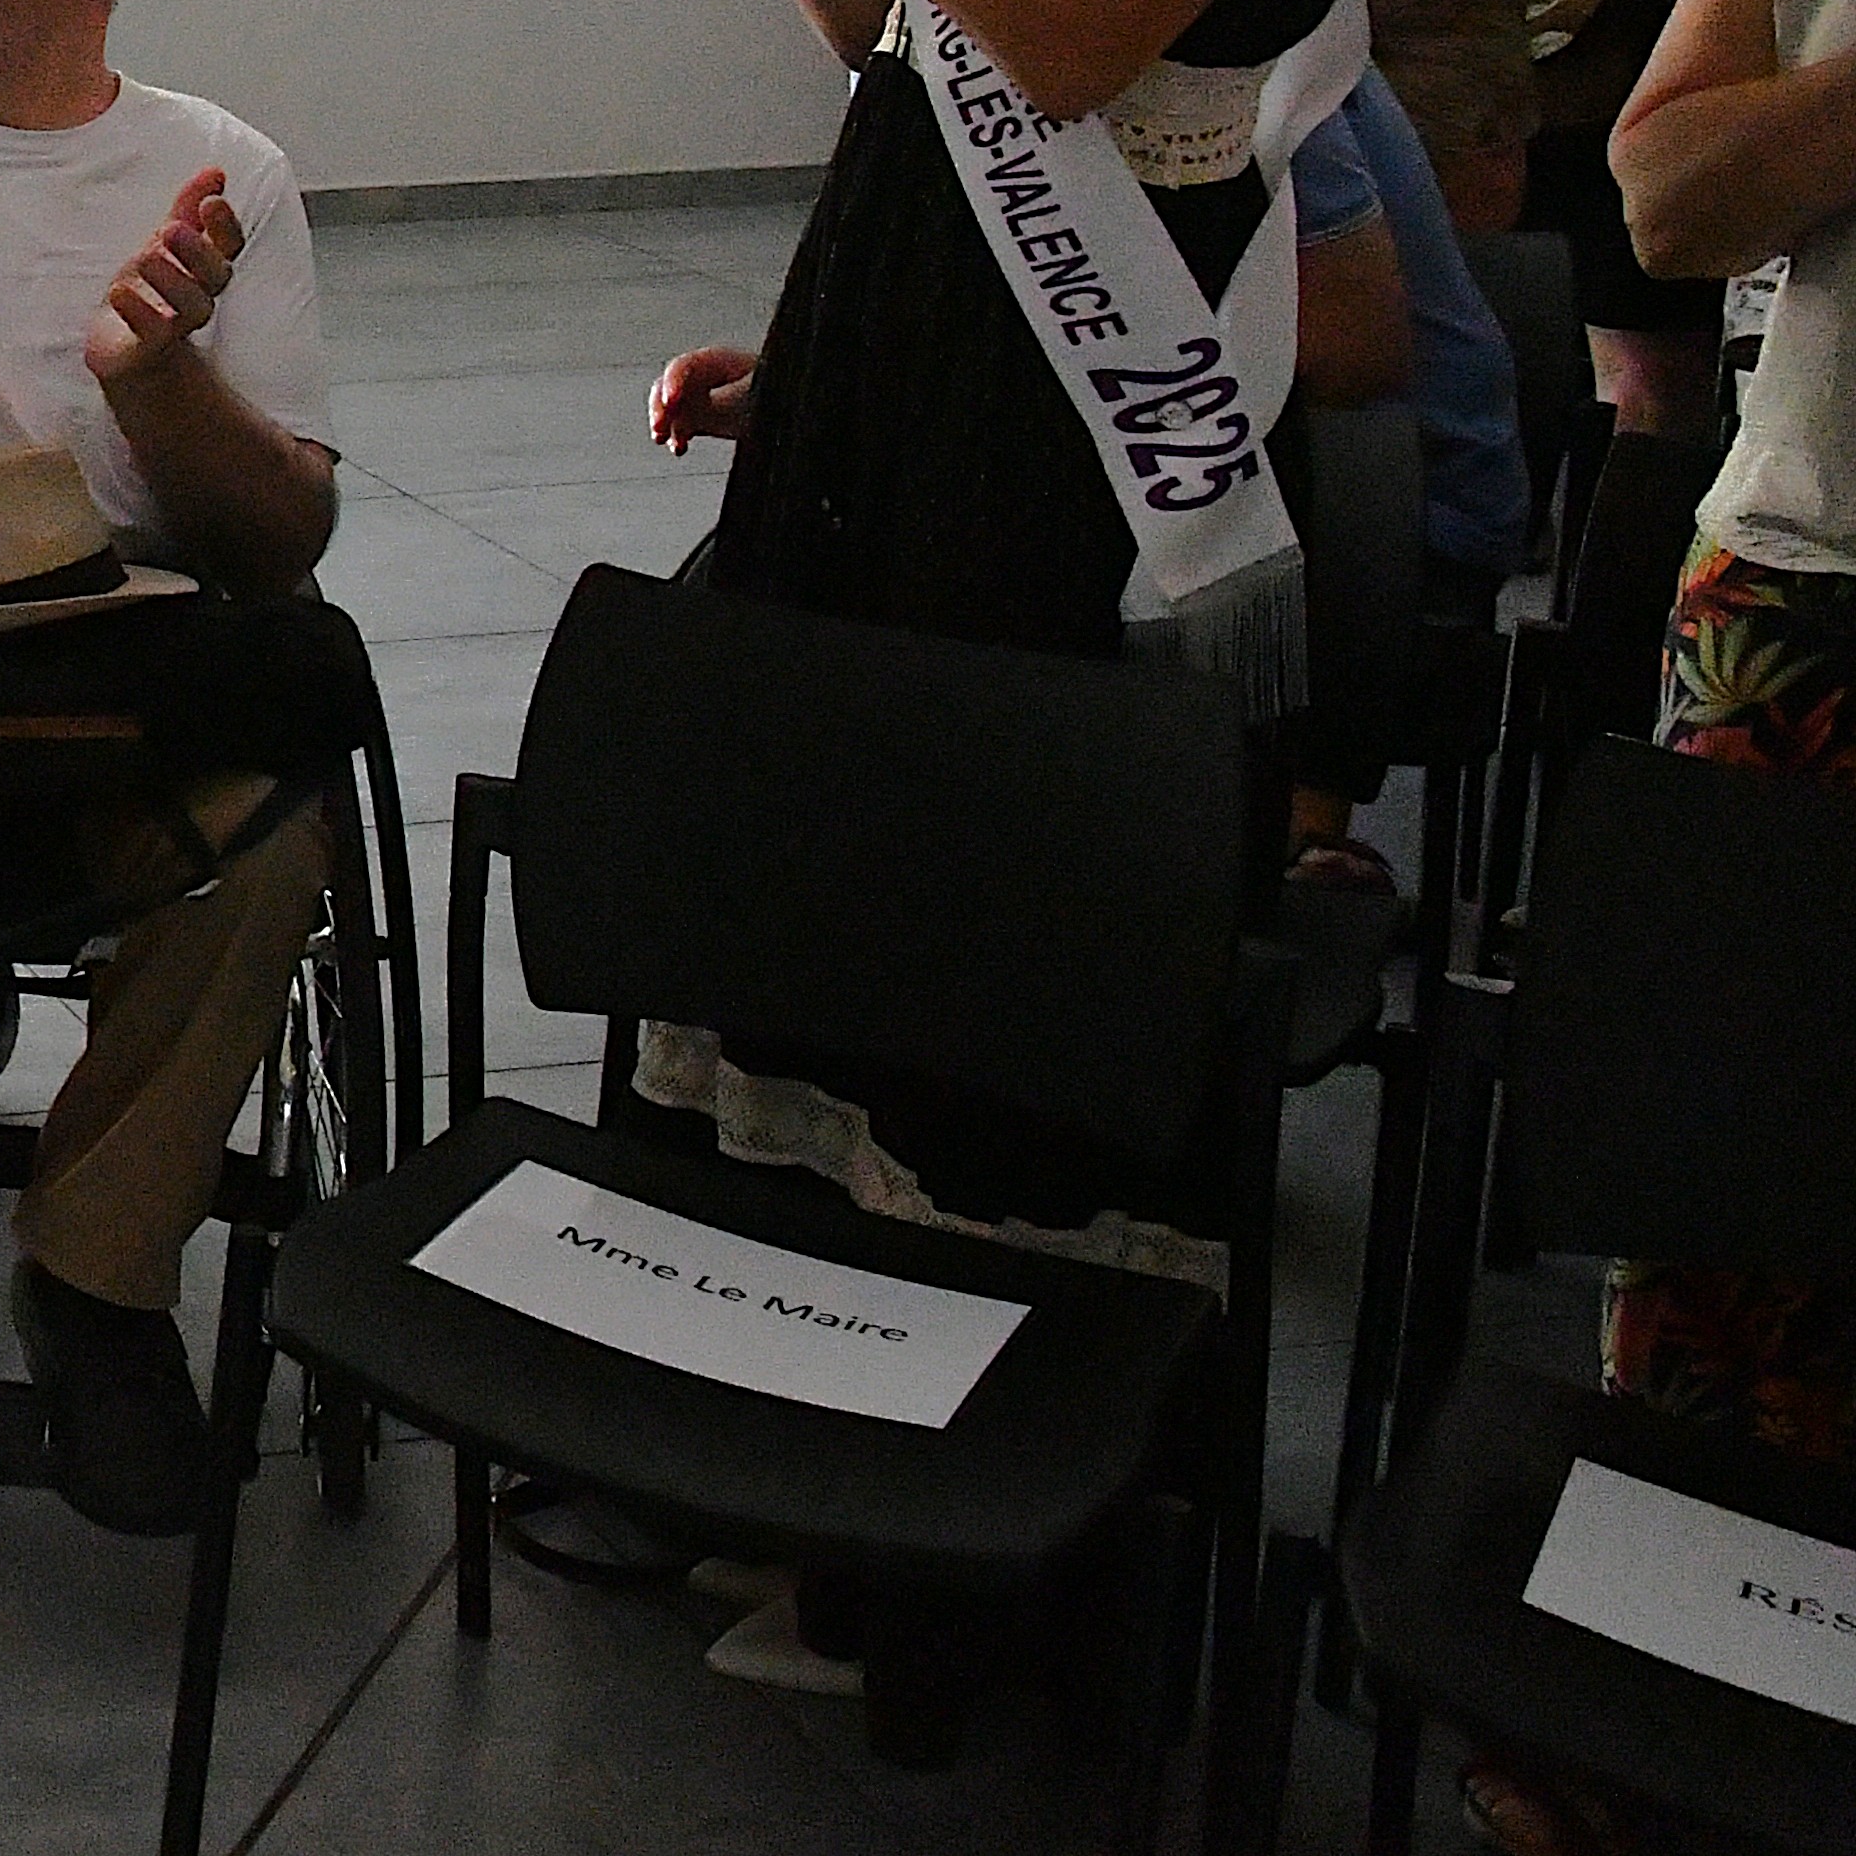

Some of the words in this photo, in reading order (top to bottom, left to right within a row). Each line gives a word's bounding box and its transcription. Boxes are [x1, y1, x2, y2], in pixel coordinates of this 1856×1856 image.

[1086, 336, 1260, 512] 2025
[556, 1225, 680, 1281] Mme
[693, 1275, 747, 1303] Le
[762, 1296, 909, 1342] Maire
